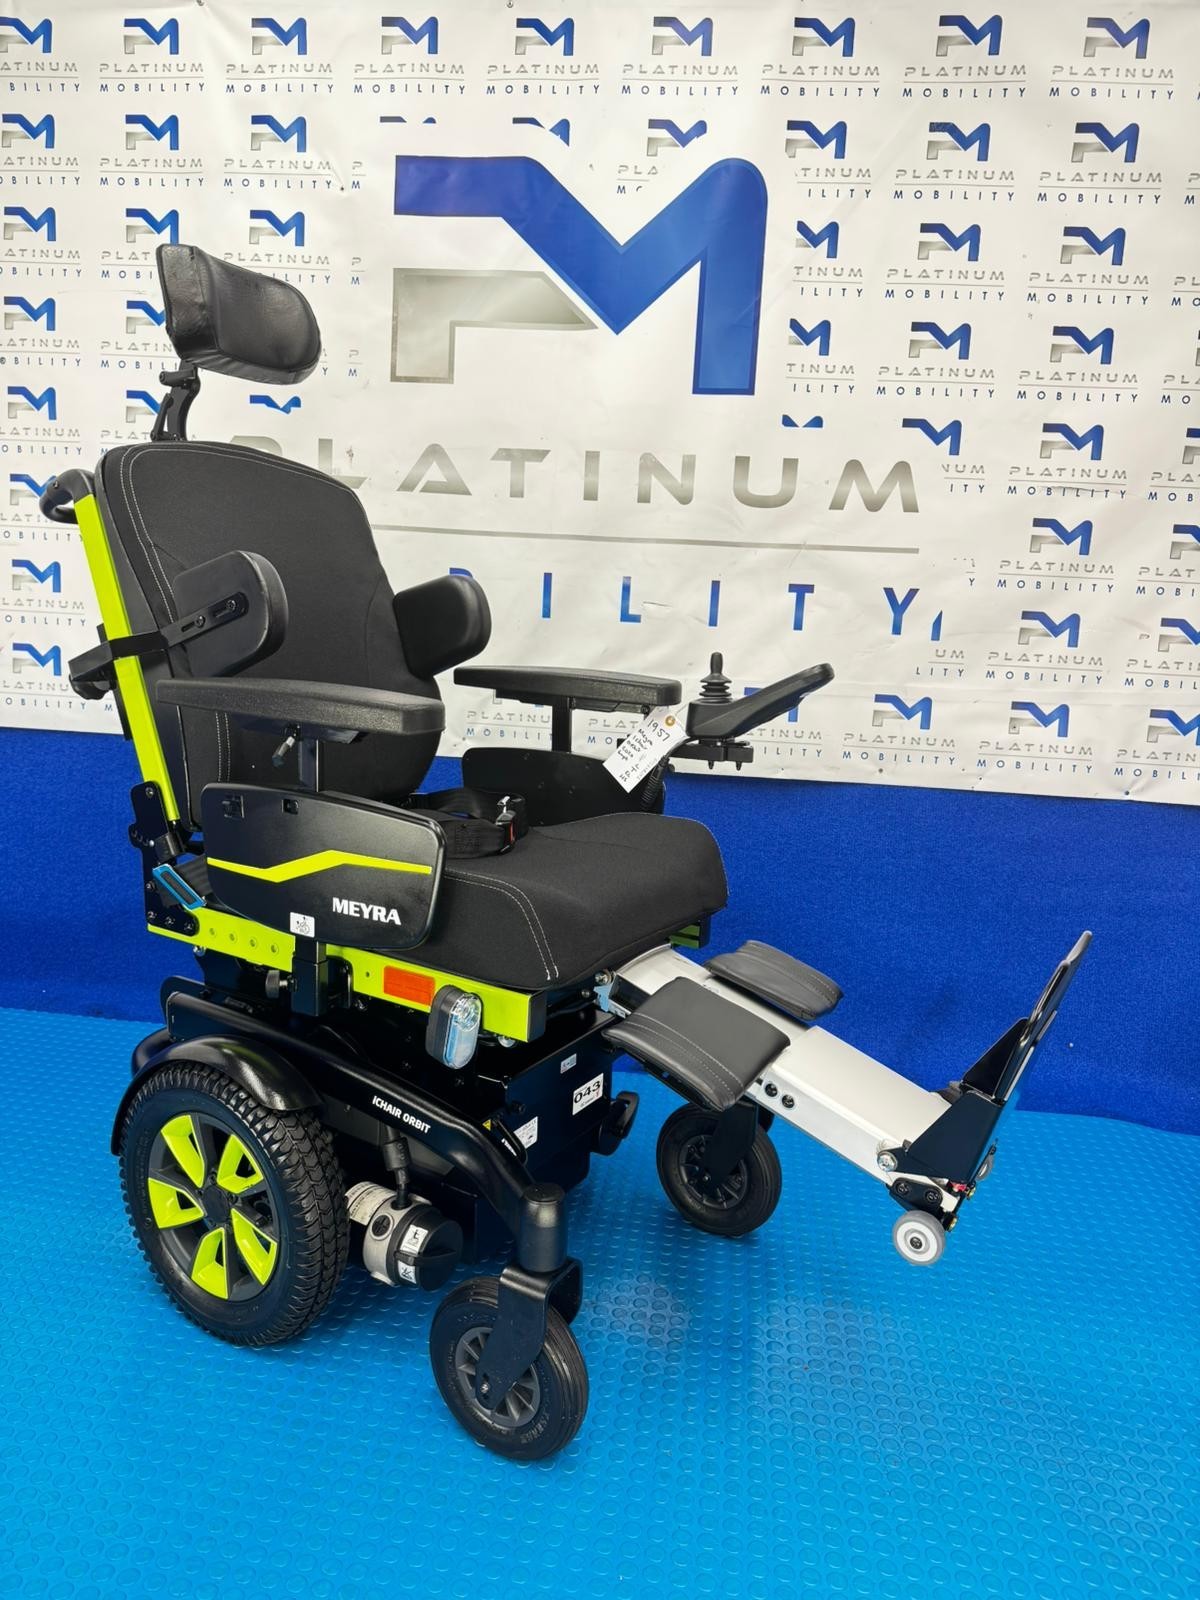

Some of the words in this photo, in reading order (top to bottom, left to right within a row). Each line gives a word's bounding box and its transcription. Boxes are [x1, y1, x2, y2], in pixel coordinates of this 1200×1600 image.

[100, 63, 204, 73] PLATINUM
[226, 64, 333, 75] PLATINUM
[354, 63, 465, 75] PLATINUM
[488, 64, 599, 75] PLATINUM
[623, 64, 738, 76] PLATINUM
[762, 64, 880, 77] PLATINUM
[905, 64, 1026, 77] PLATINUM
[1051, 65, 1174, 79] PLATINUM
[100, 83, 205, 93] MOBILITY
[226, 83, 334, 94] MOBILITY
[354, 84, 466, 95] MOBILITY
[486, 84, 600, 96] MOBILITY
[621, 84, 739, 97] MOBILITY
[760, 85, 880, 98] MOBILITY
[903, 87, 1026, 99] MOBILITY
[1049, 87, 1174, 100] MOBILITY
[100, 158, 203, 169] PLATINUM
[224, 159, 332, 171] PLATINUM
[795, 167, 872, 179] TINUM
[896, 169, 1015, 181] PLATINUM
[1040, 171, 1163, 184] PLATINUM
[100, 177, 204, 188] MOBILITY
[224, 178, 332, 190] MOBILITY
[894, 190, 1015, 202] MOBILITY
[1037, 192, 1162, 205] MOBILITY
[223, 252, 331, 265] PLATINUM
[887, 268, 1005, 281] PLATINUM
[1029, 272, 1150, 285] PLATINUM
[885, 289, 1005, 302] MOBILITY
[1027, 292, 1149, 306] MOBILITY
[878, 365, 995, 379] PLATINUM
[1019, 370, 1138, 384] PLATINUM
[877, 386, 995, 399] MOBILITY
[1017, 390, 1139, 404] MOBILITY
[1008, 465, 1128, 480] PLATINUM
[1006, 485, 1128, 501] MOBILITY
[1000, 559, 1115, 574] PLATINUM
[997, 579, 1114, 593] MOBILITY
[449, 568, 919, 636] ILITY
[988, 651, 1104, 667] PLATINUM
[1127, 658, 1200, 672] PLATI
[986, 670, 1103, 685] MOBILITY
[647, 719, 671, 742] 1957
[843, 732, 956, 748] PLATINUM
[978, 741, 1093, 756] PLATINUM
[843, 751, 956, 766] MOBILITY
[977, 758, 1093, 774] MOBILITY
[332, 896, 402, 926] MEYRA
[573, 1080, 601, 1104] 043
[372, 1095, 402, 1119] ICHAIR
[402, 1112, 431, 1134] ORBIT
